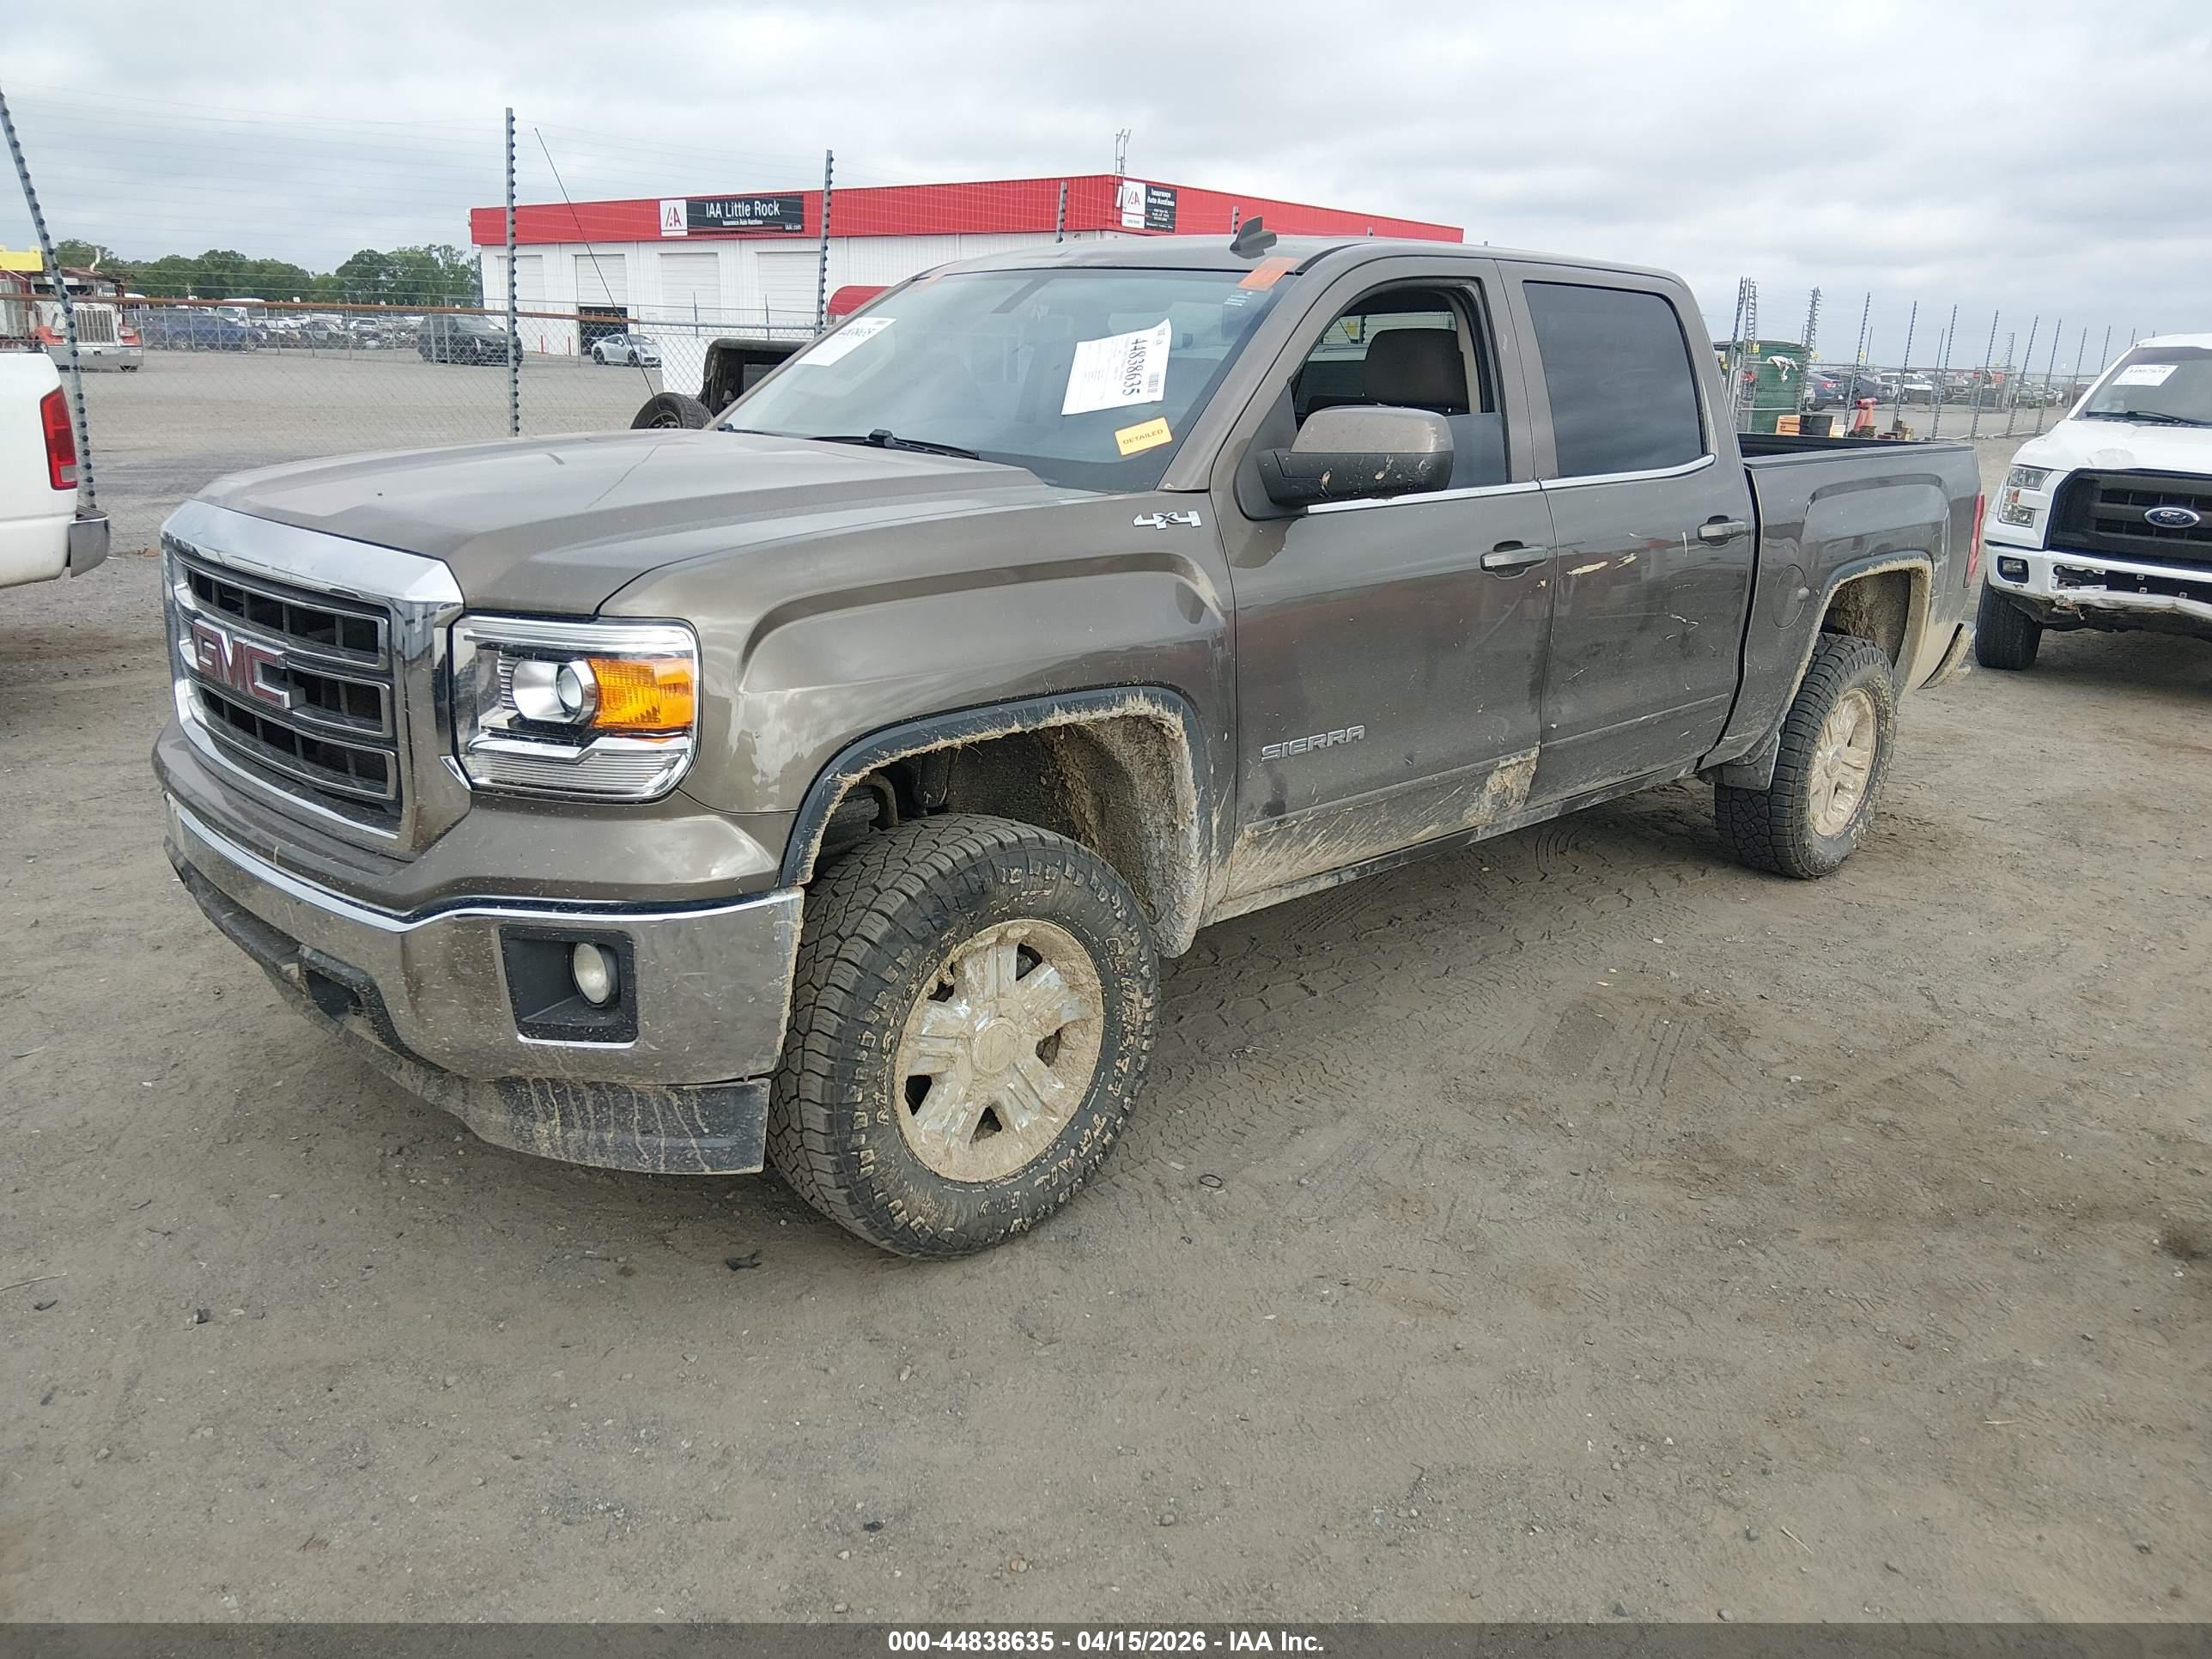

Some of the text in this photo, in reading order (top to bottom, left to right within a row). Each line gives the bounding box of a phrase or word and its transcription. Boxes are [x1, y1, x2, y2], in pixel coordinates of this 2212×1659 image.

[706, 199, 781, 218] IAA Little Rock
[1121, 338, 1148, 396] 44838635
[1122, 428, 1164, 445] DETAILED
[191, 618, 291, 708] GMC
[1261, 725, 1365, 763] SIERRA
